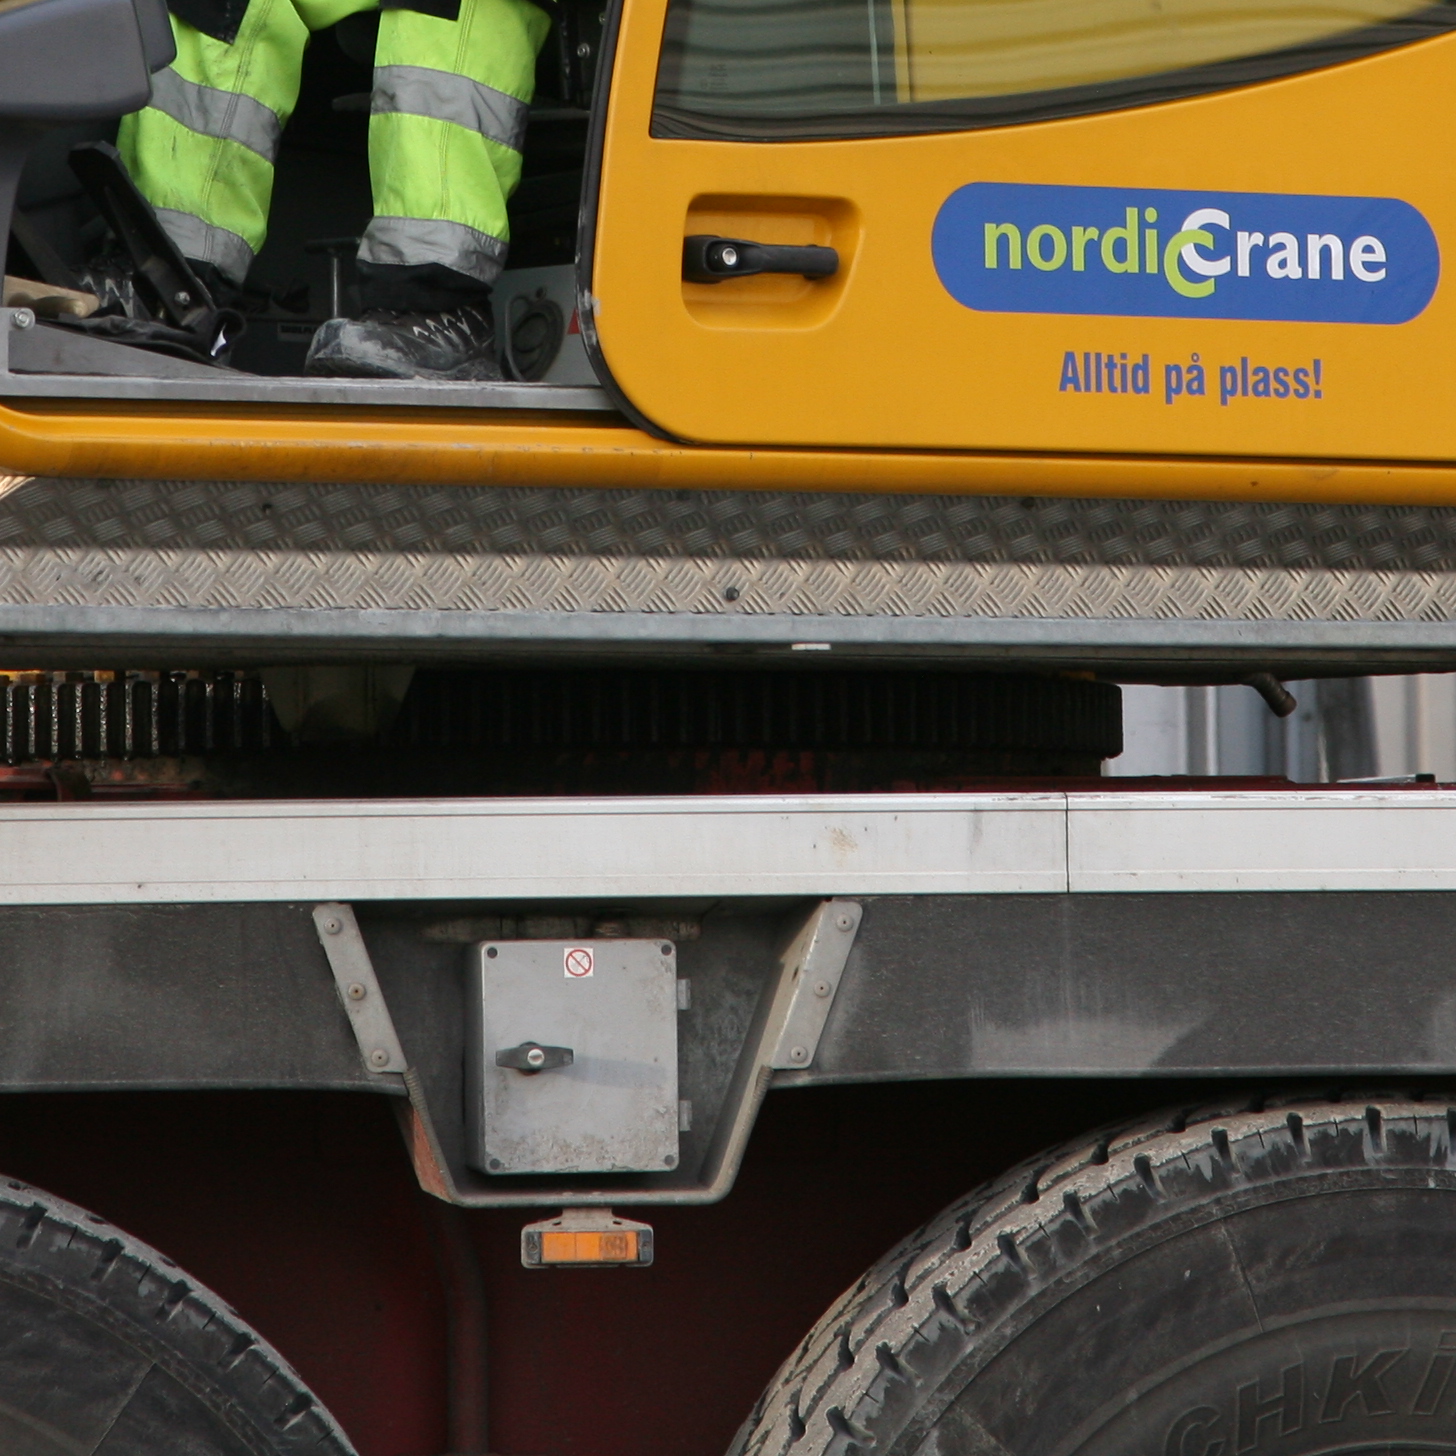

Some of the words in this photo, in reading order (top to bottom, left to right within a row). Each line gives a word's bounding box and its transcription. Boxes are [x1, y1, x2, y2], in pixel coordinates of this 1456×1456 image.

[1058, 350, 1150, 395] Alltid
[1164, 352, 1206, 405] på
[1219, 356, 1323, 407] plass!
